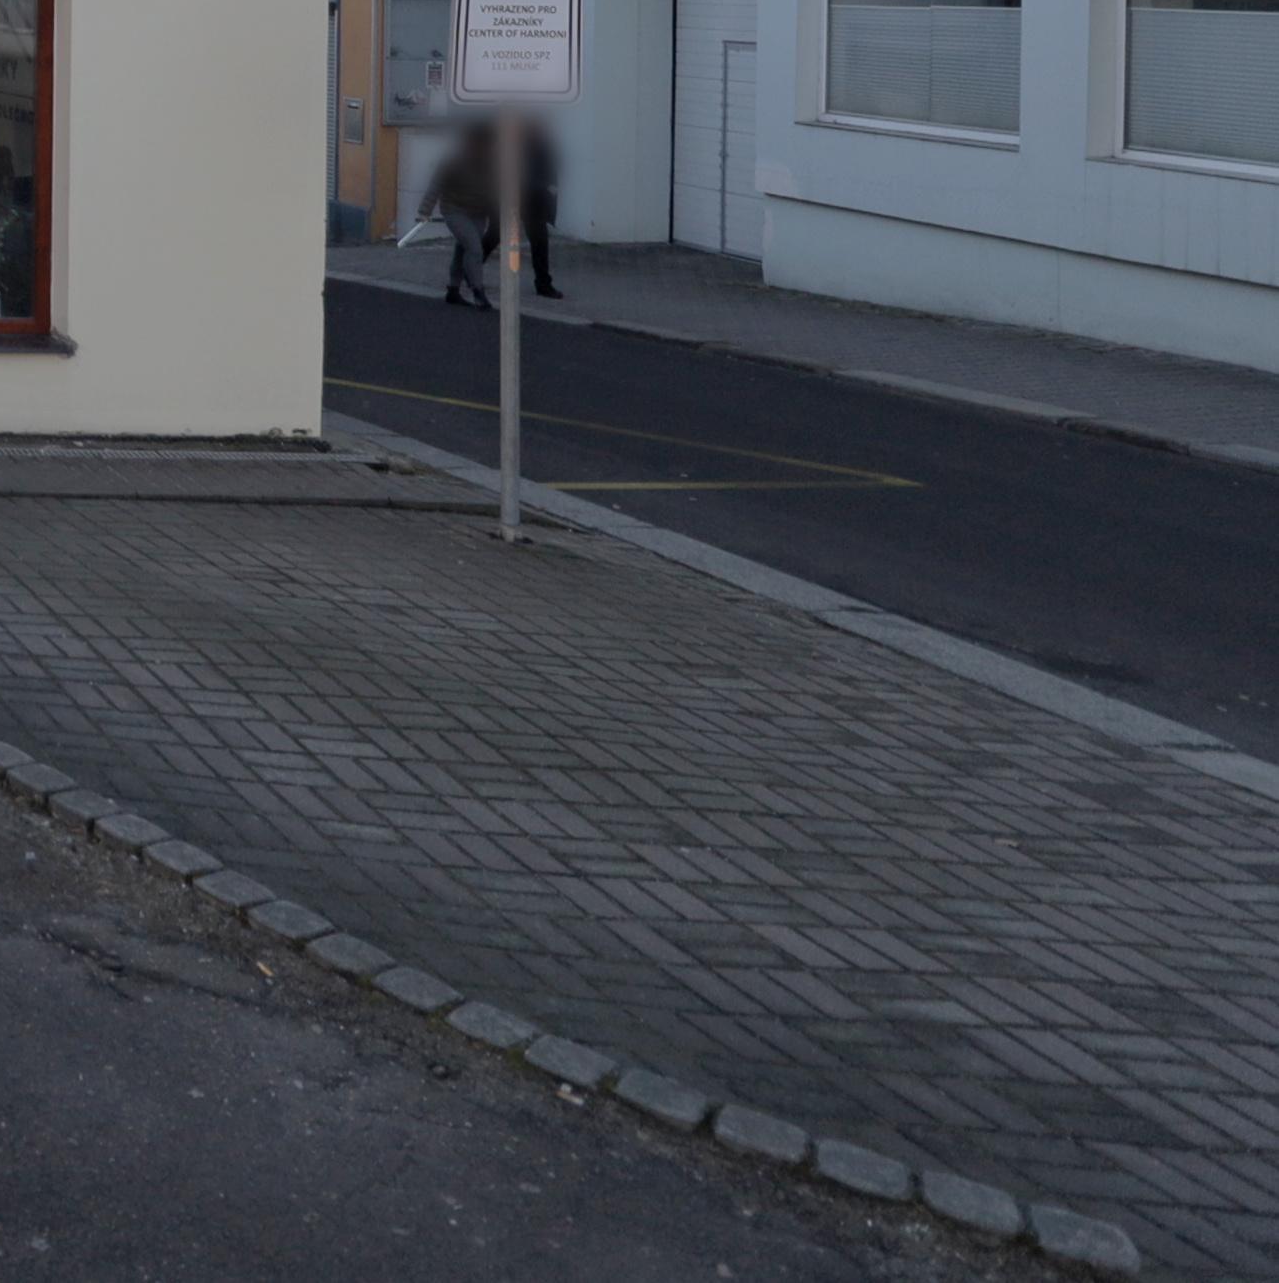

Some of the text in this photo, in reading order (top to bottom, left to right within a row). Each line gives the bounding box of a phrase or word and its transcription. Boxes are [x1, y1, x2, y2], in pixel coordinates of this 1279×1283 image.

[479, 4, 558, 15] VYHRAZENO PRO
[492, 16, 544, 27] ZÁKAZNÍKY
[468, 29, 504, 39] CENTER
[505, 29, 519, 39] OF
